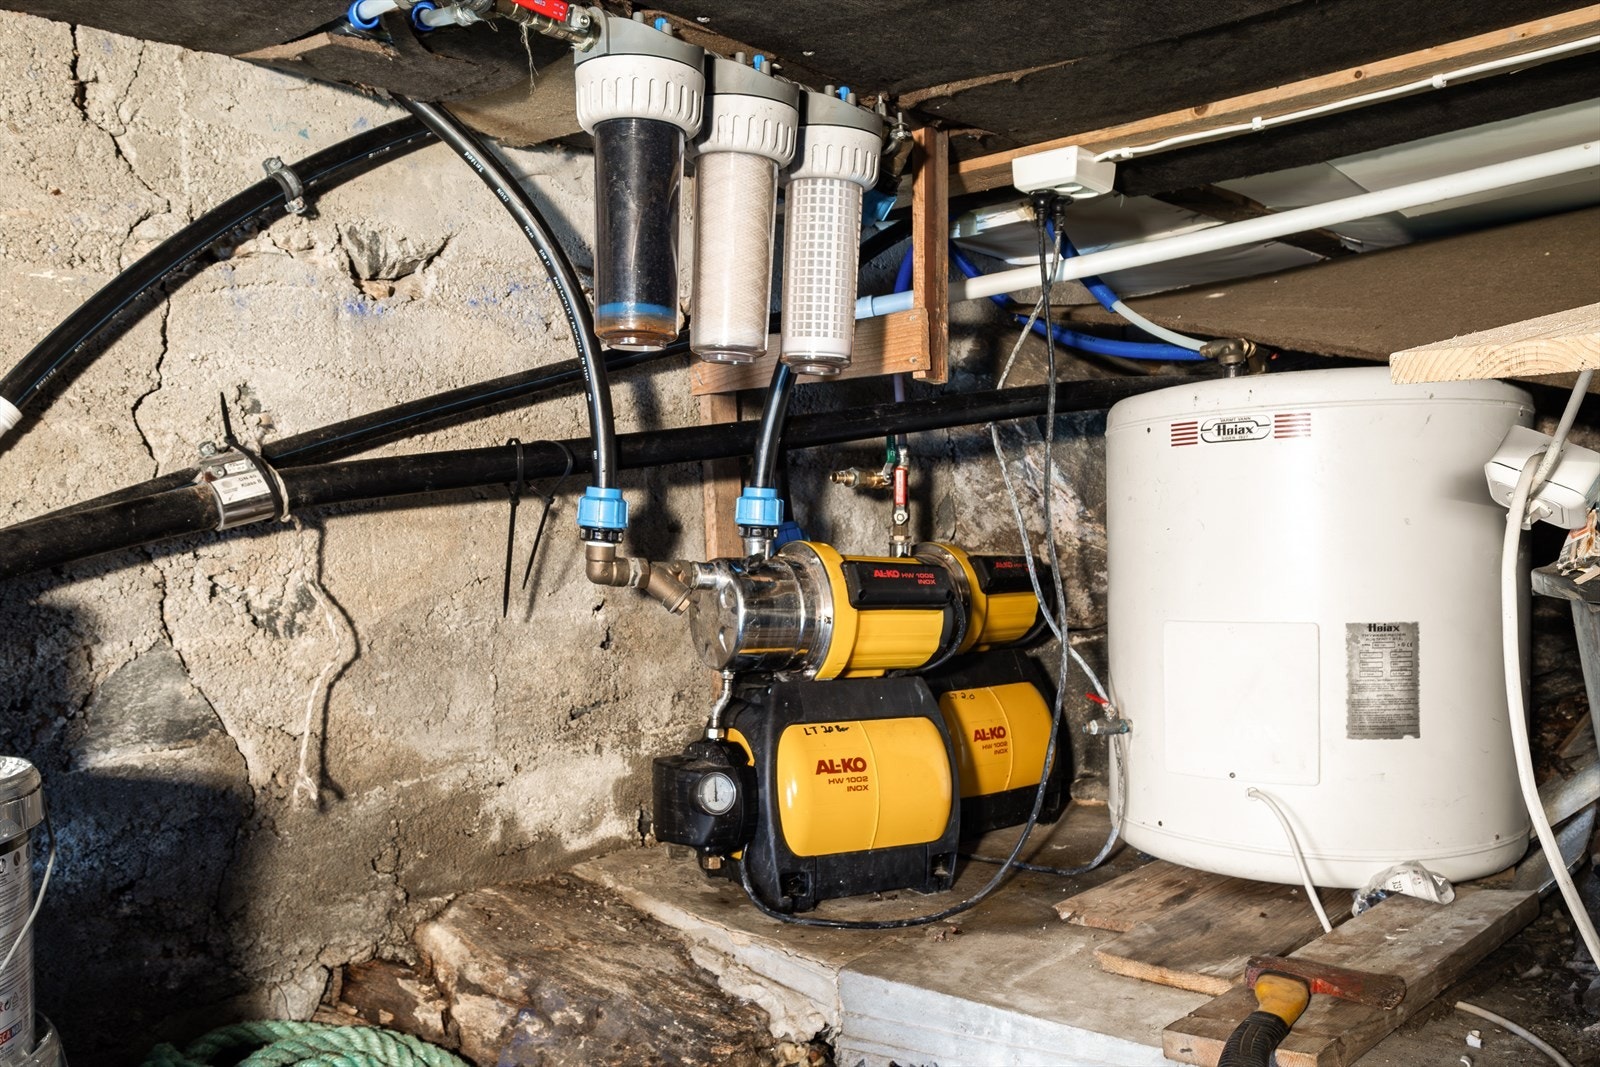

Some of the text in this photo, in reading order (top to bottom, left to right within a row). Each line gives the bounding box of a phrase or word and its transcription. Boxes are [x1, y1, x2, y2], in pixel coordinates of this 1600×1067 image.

[1215, 424, 1254, 436] Høiax
[873, 569, 900, 578] AL-KO
[1367, 623, 1400, 632] Høiax
[803, 726, 818, 736] LT
[973, 725, 1007, 743] AL-KO
[815, 757, 867, 775] AL-KO
[828, 775, 868, 785] HW 1002
[846, 784, 869, 792] INOX
